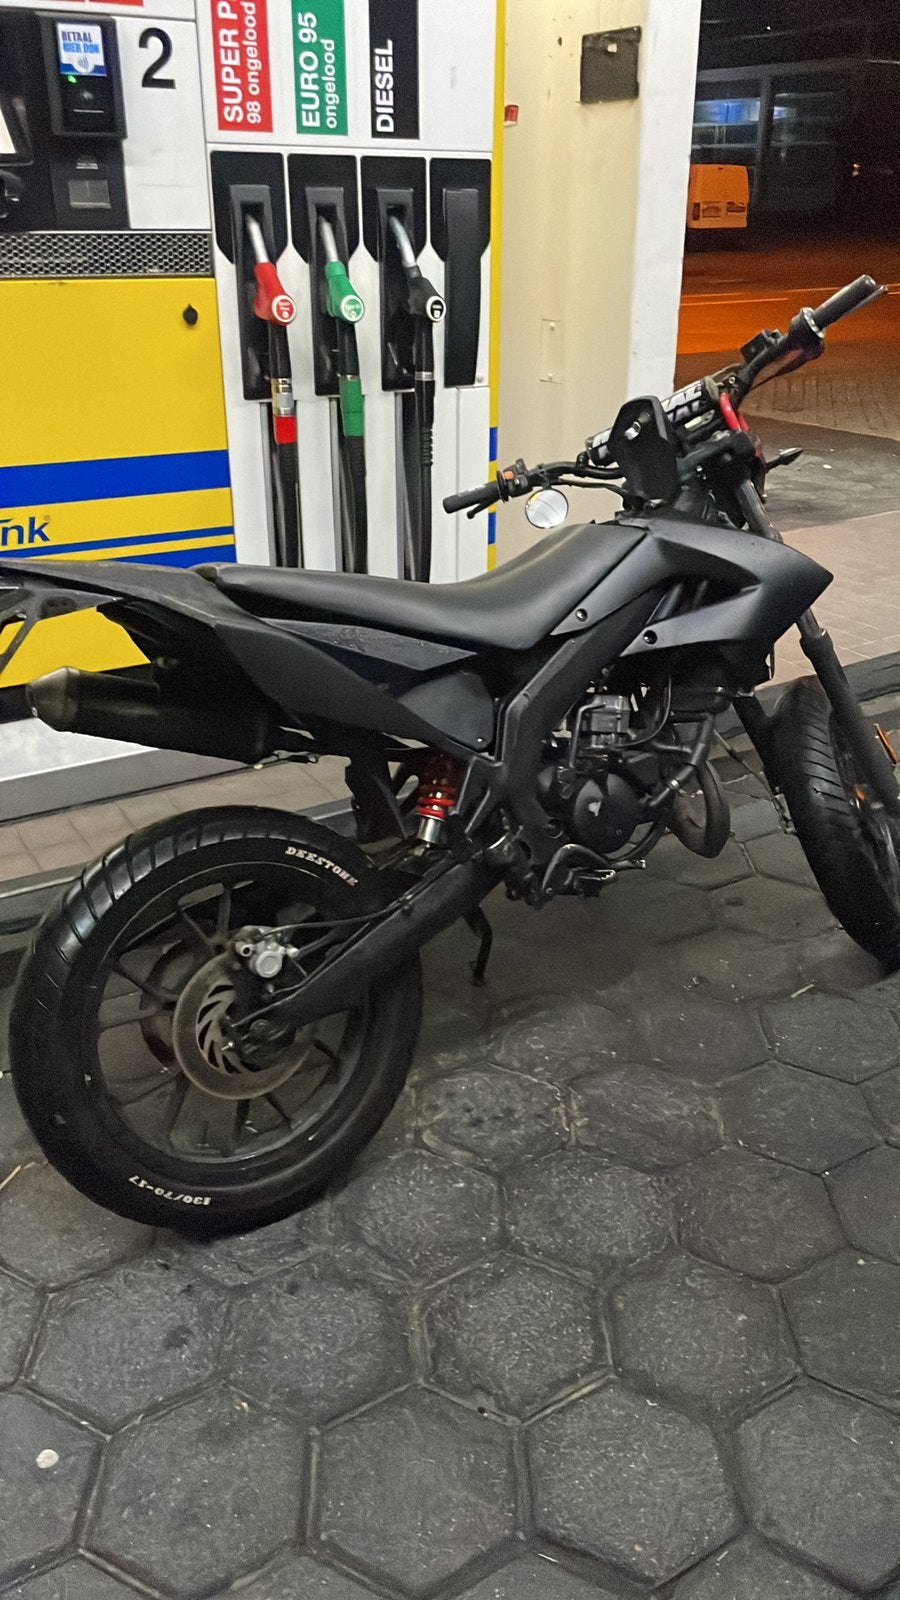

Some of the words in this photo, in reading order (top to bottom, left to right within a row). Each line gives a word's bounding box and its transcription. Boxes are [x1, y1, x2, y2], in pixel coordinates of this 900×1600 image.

[217, 0, 238, 19] P
[298, 12, 317, 44] 95
[138, 27, 177, 90] 2
[240, 1, 262, 95] ongelood
[219, 28, 244, 123] SUPER
[299, 50, 320, 128] EURO
[320, 39, 340, 129] ongelood
[374, 38, 394, 133] DIESEL
[246, 101, 262, 124] 98
[0, 516, 50, 546] nk
[285, 846, 358, 886] DEESTONE
[129, 1175, 211, 1205] 130/70-17
